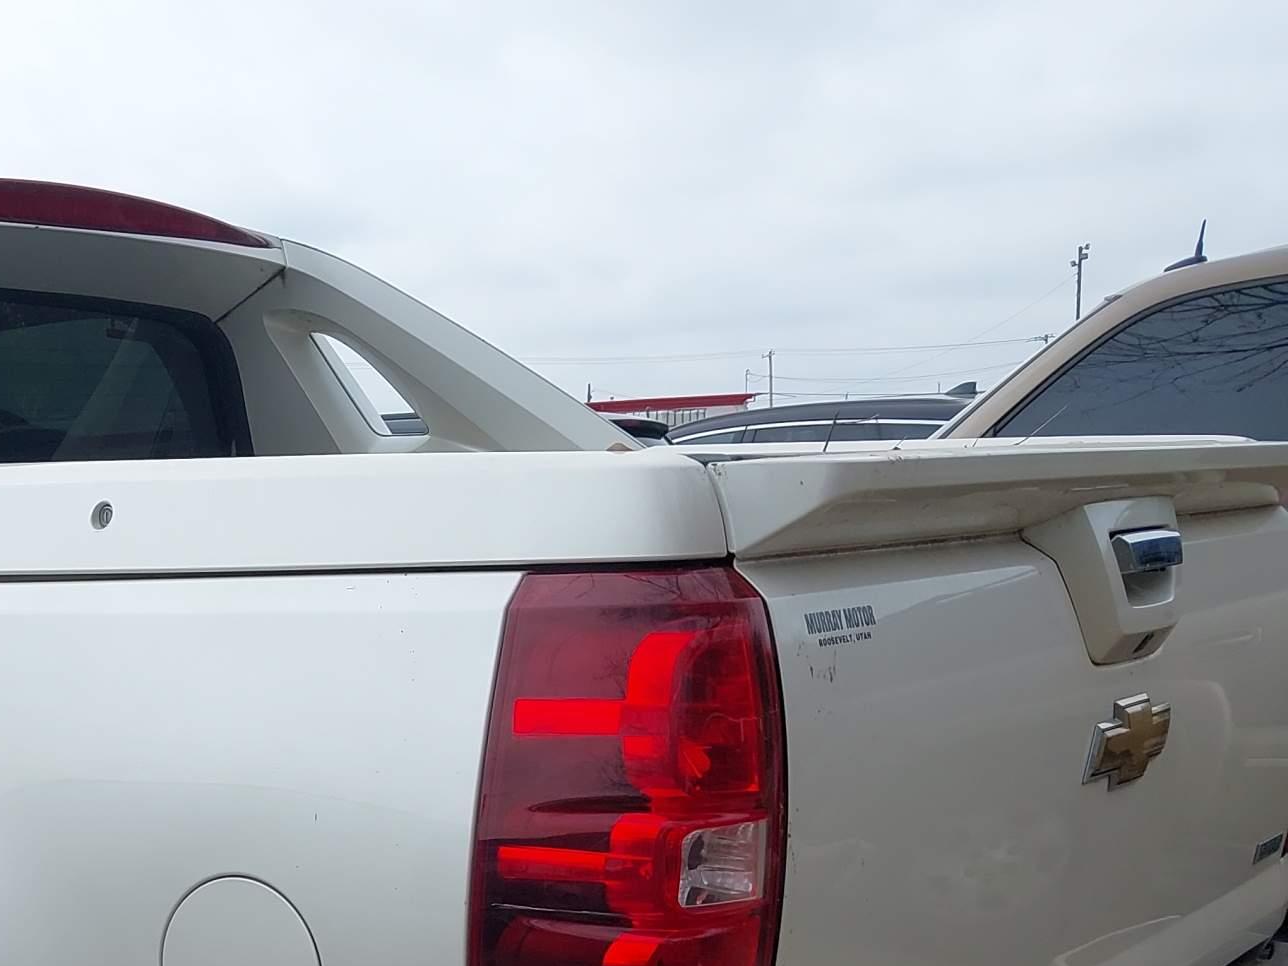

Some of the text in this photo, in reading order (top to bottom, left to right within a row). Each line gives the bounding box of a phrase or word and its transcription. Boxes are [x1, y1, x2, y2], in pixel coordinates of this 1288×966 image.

[804, 605, 876, 635] MURRAY MOTOR
[855, 632, 872, 641] UTAH
